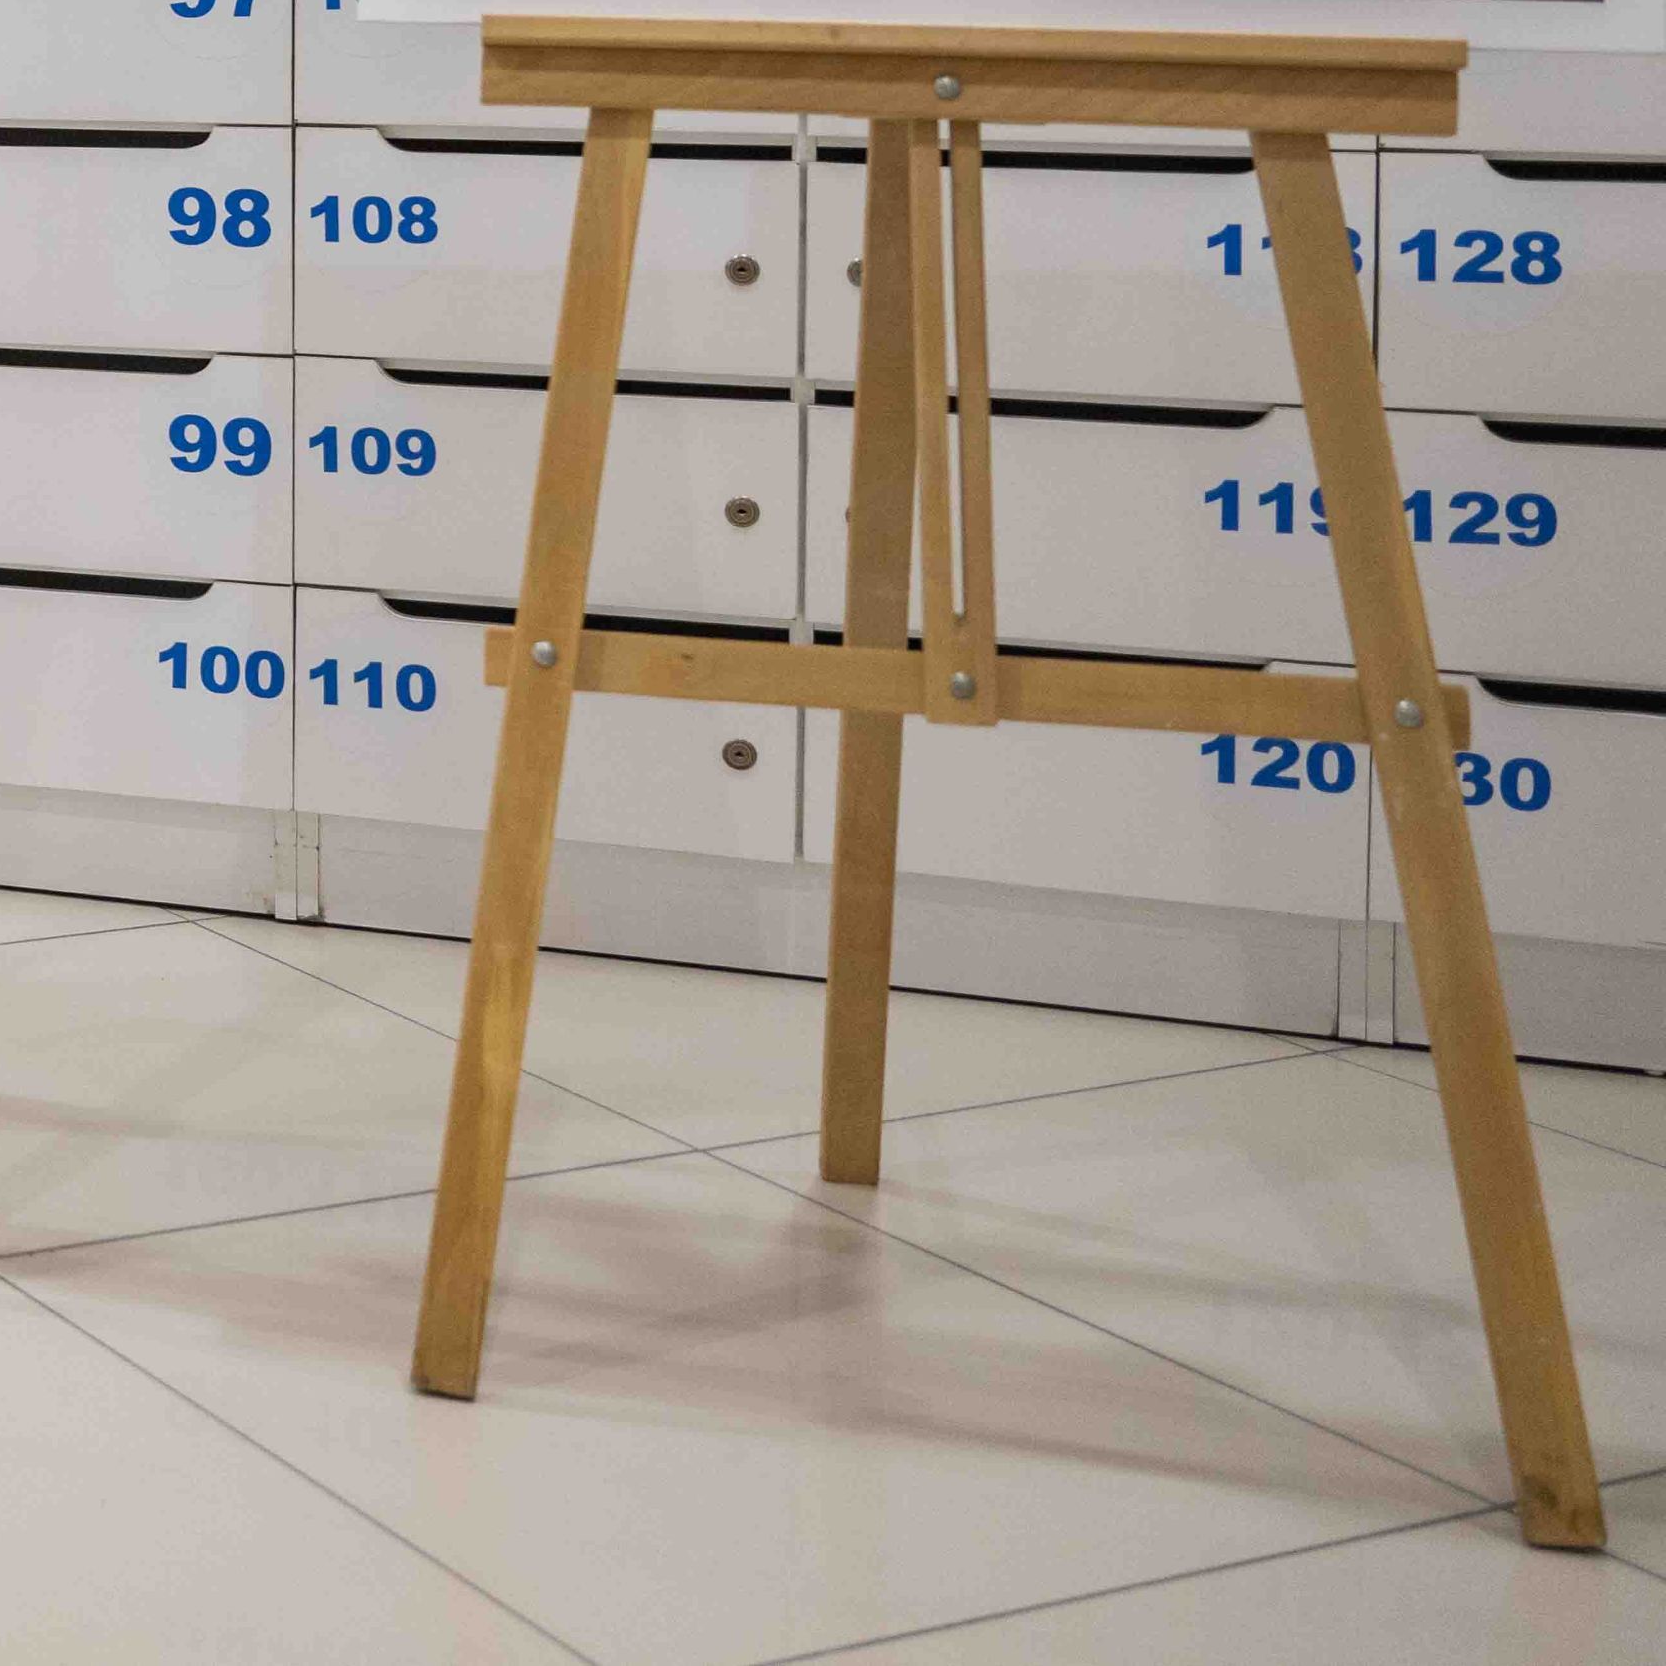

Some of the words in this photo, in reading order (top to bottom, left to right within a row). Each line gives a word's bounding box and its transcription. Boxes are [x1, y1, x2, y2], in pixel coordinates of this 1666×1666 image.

[167, 187, 272, 248] 98
[309, 195, 439, 244] 108
[1400, 229, 1563, 285] 128
[168, 414, 272, 476] 99
[308, 426, 437, 476] 109
[1403, 489, 1558, 548] 129
[158, 642, 285, 699] 100
[308, 659, 437, 712] 110
[1200, 734, 1356, 793] 120
[1453, 751, 1552, 812] 30
